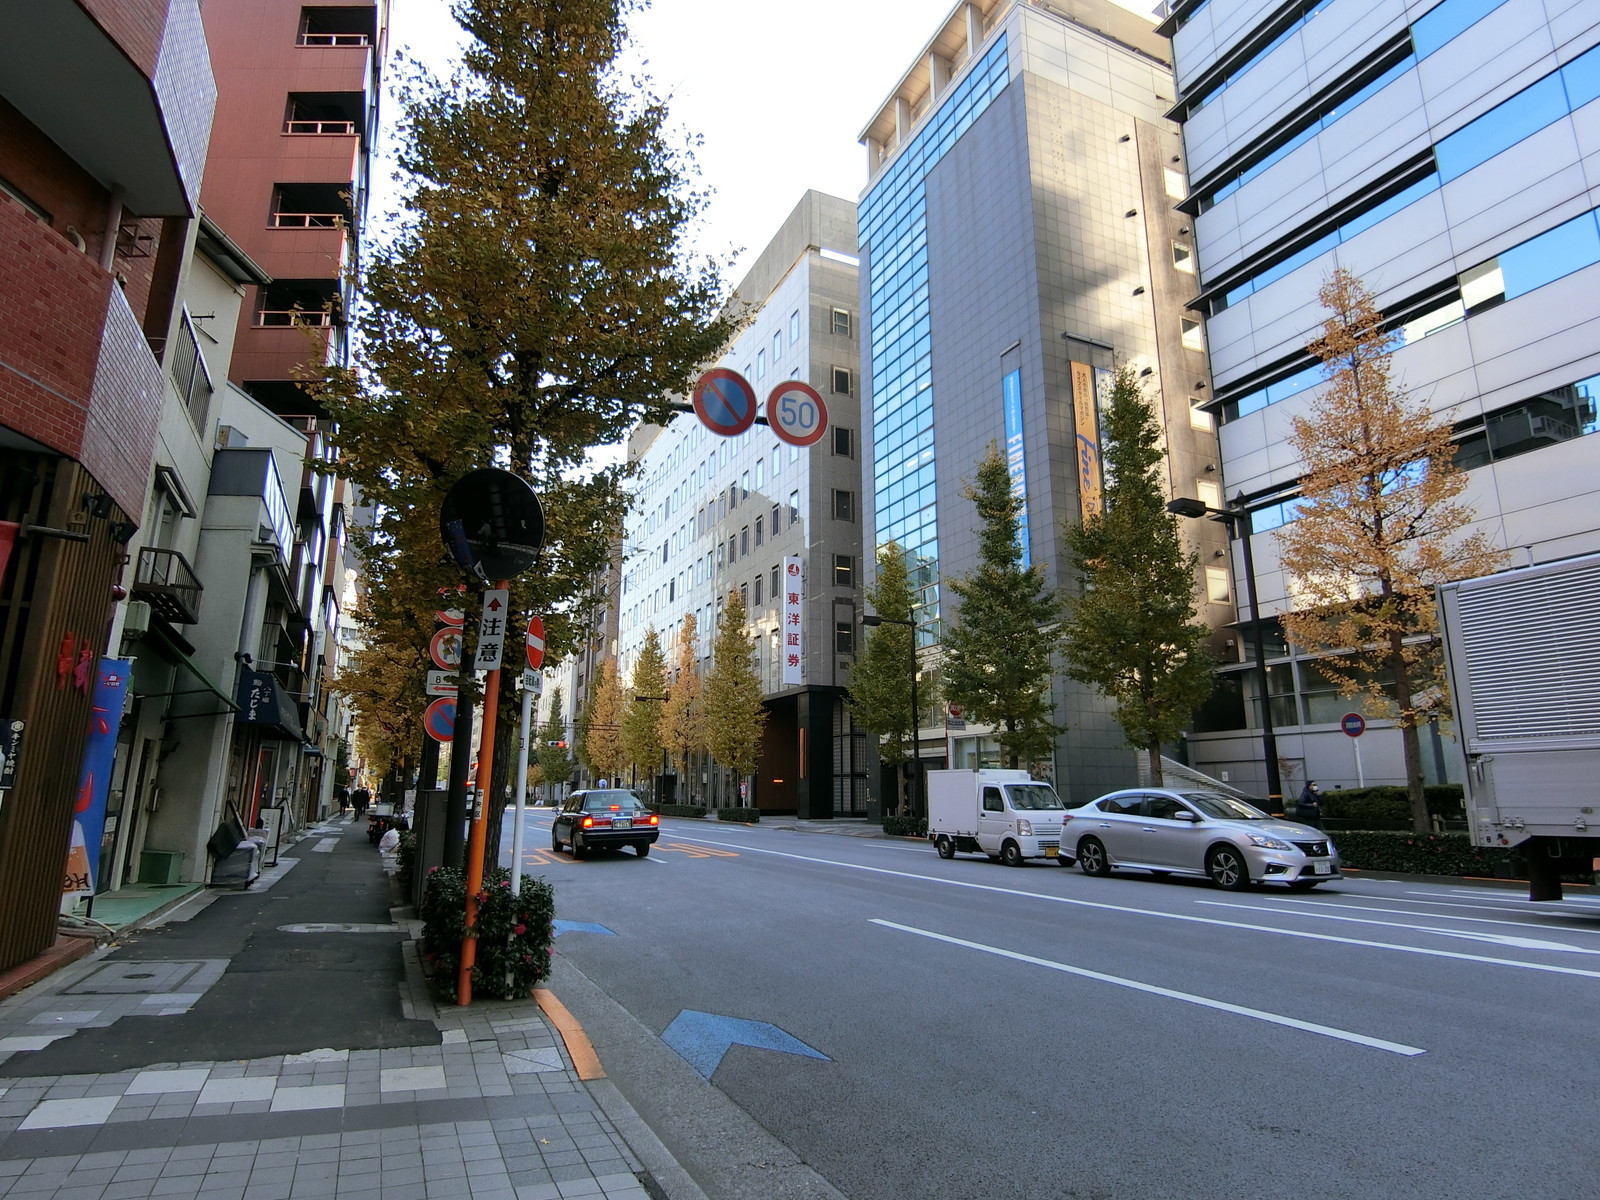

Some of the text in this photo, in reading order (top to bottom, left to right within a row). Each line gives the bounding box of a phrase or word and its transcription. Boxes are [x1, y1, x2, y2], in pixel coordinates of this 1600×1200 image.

[781, 397, 814, 429] 50
[1076, 433, 1098, 492] Fine
[478, 617, 502, 662] 注意
[787, 592, 800, 667] 東洋証券
[475, 791, 483, 818] 中央区
